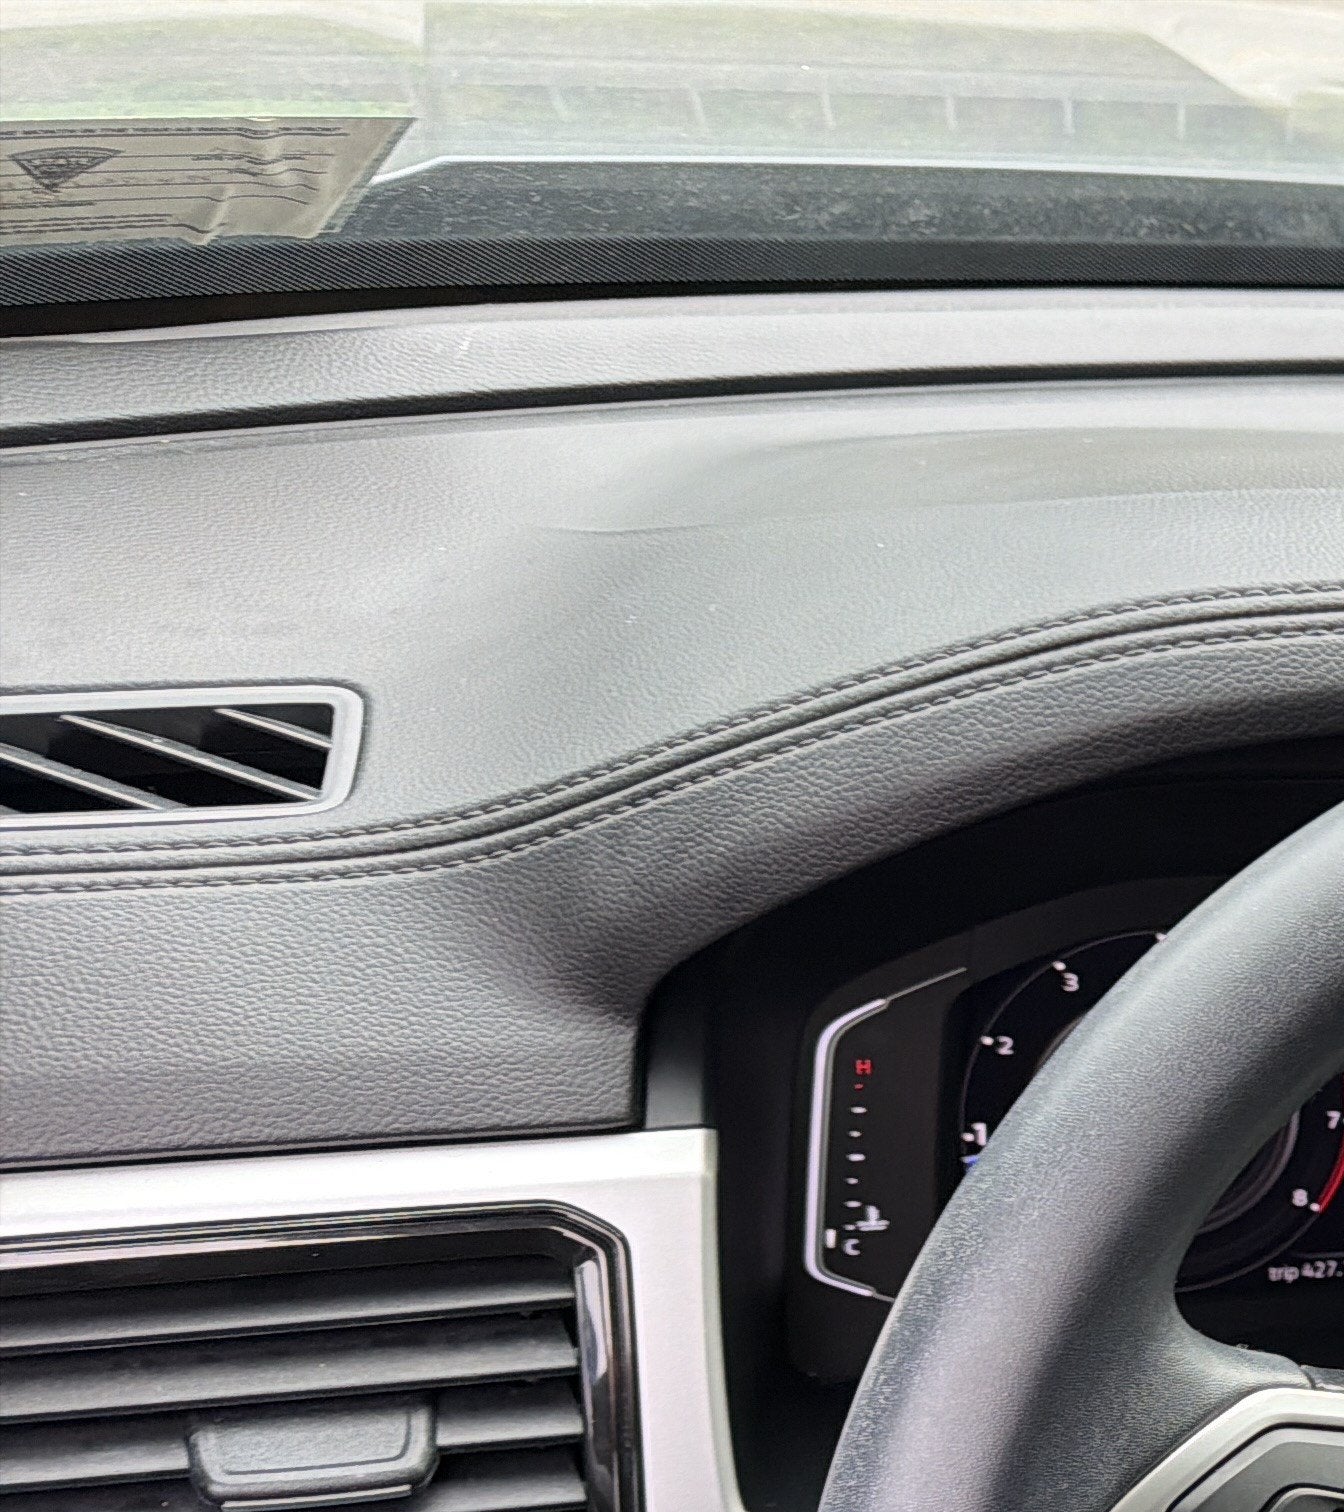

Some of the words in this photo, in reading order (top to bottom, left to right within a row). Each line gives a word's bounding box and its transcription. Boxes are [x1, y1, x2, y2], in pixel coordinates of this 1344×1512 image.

[1062, 972, 1080, 992] 3
[996, 1036, 1014, 1055] 2
[855, 1059, 872, 1075] H
[1326, 1110, 1340, 1128] 7
[971, 1123, 987, 1146] 1
[1291, 1189, 1307, 1206] 8
